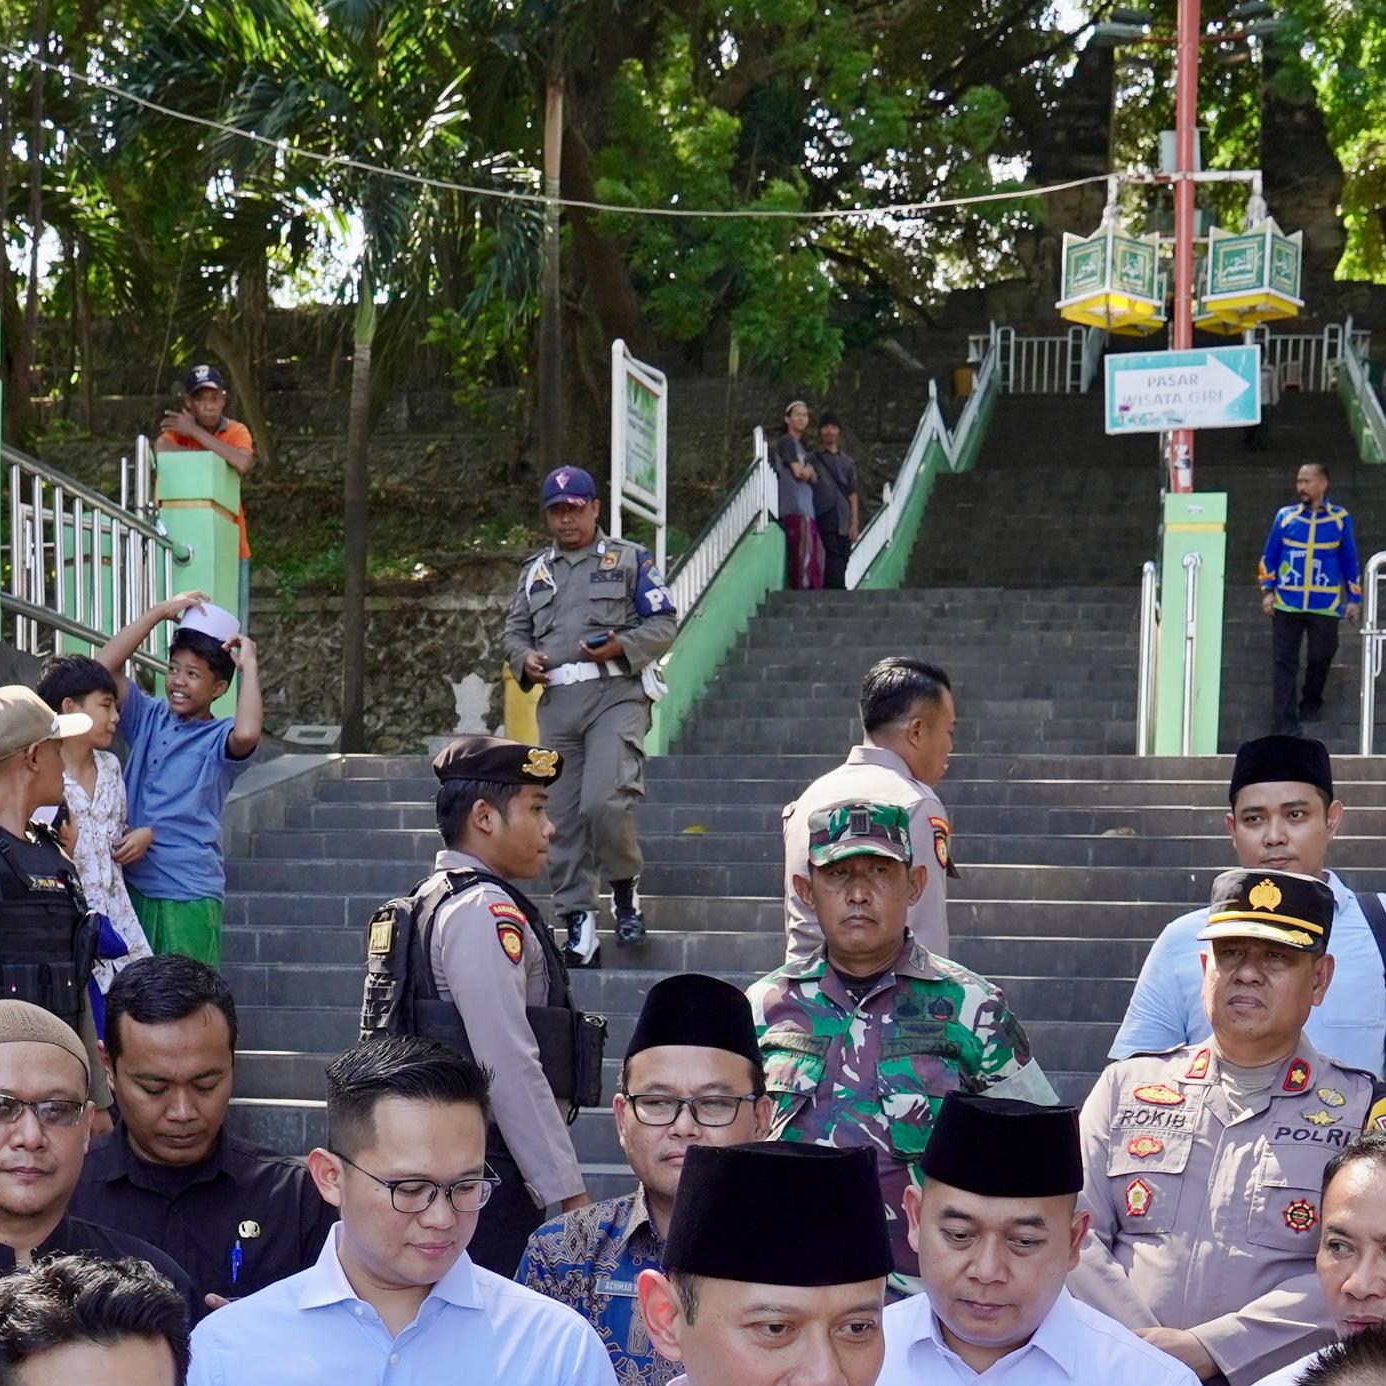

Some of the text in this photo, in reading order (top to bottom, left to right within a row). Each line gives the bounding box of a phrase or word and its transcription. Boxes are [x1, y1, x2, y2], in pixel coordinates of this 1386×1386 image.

[1147, 374, 1198, 388] PASAR
[1123, 390, 1222, 405] WISATA GIRI
[1120, 1110, 1187, 1128] ROKIB
[1274, 1126, 1351, 1148] POLRI
[604, 1282, 633, 1292] ACHMAD
